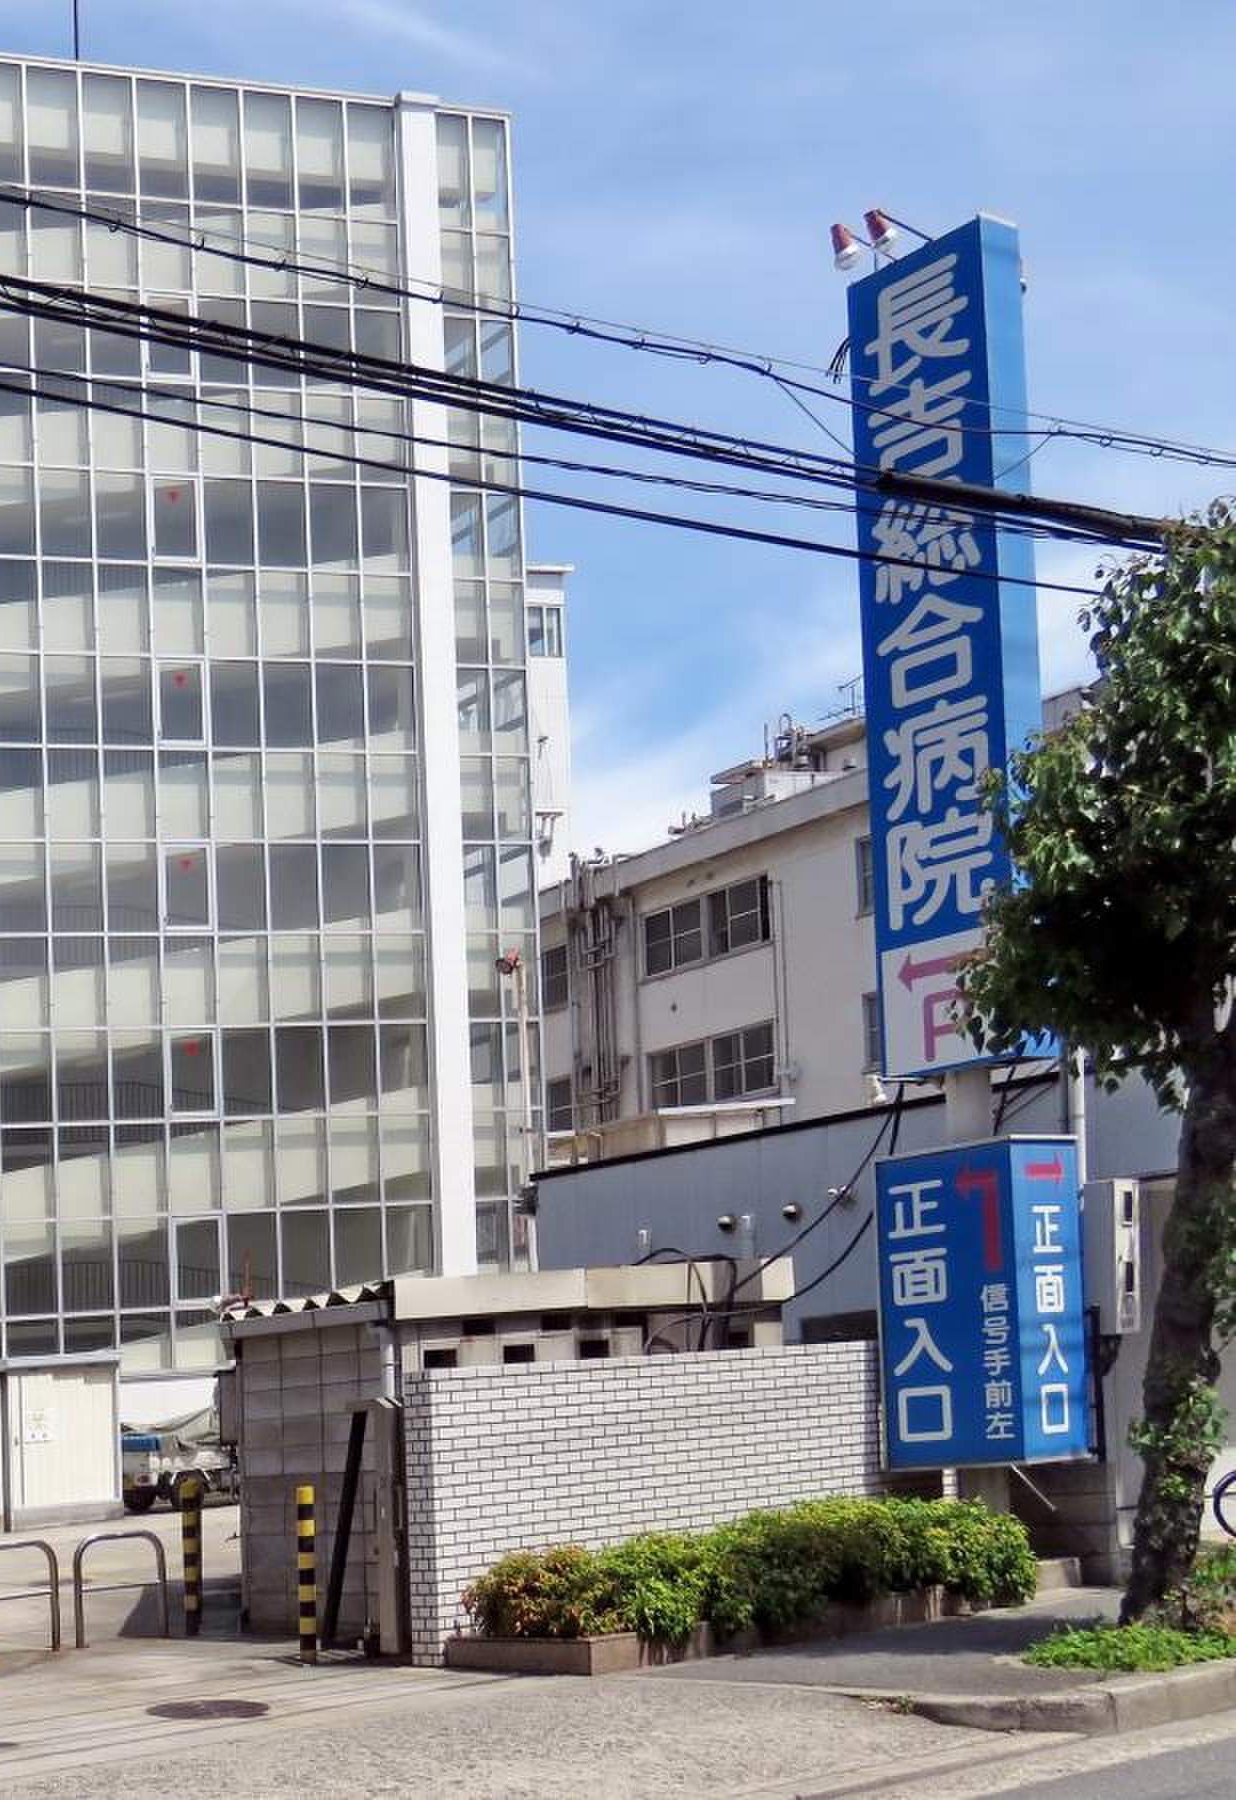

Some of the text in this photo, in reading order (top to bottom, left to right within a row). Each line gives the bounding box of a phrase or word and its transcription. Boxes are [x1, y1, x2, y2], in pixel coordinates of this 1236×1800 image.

[864, 252, 995, 932] 長吉総合病院
[887, 1178, 954, 1442] 正面入口
[978, 1282, 1016, 1441] 信号手前左
[1031, 1204, 1069, 1435] 正面入口
